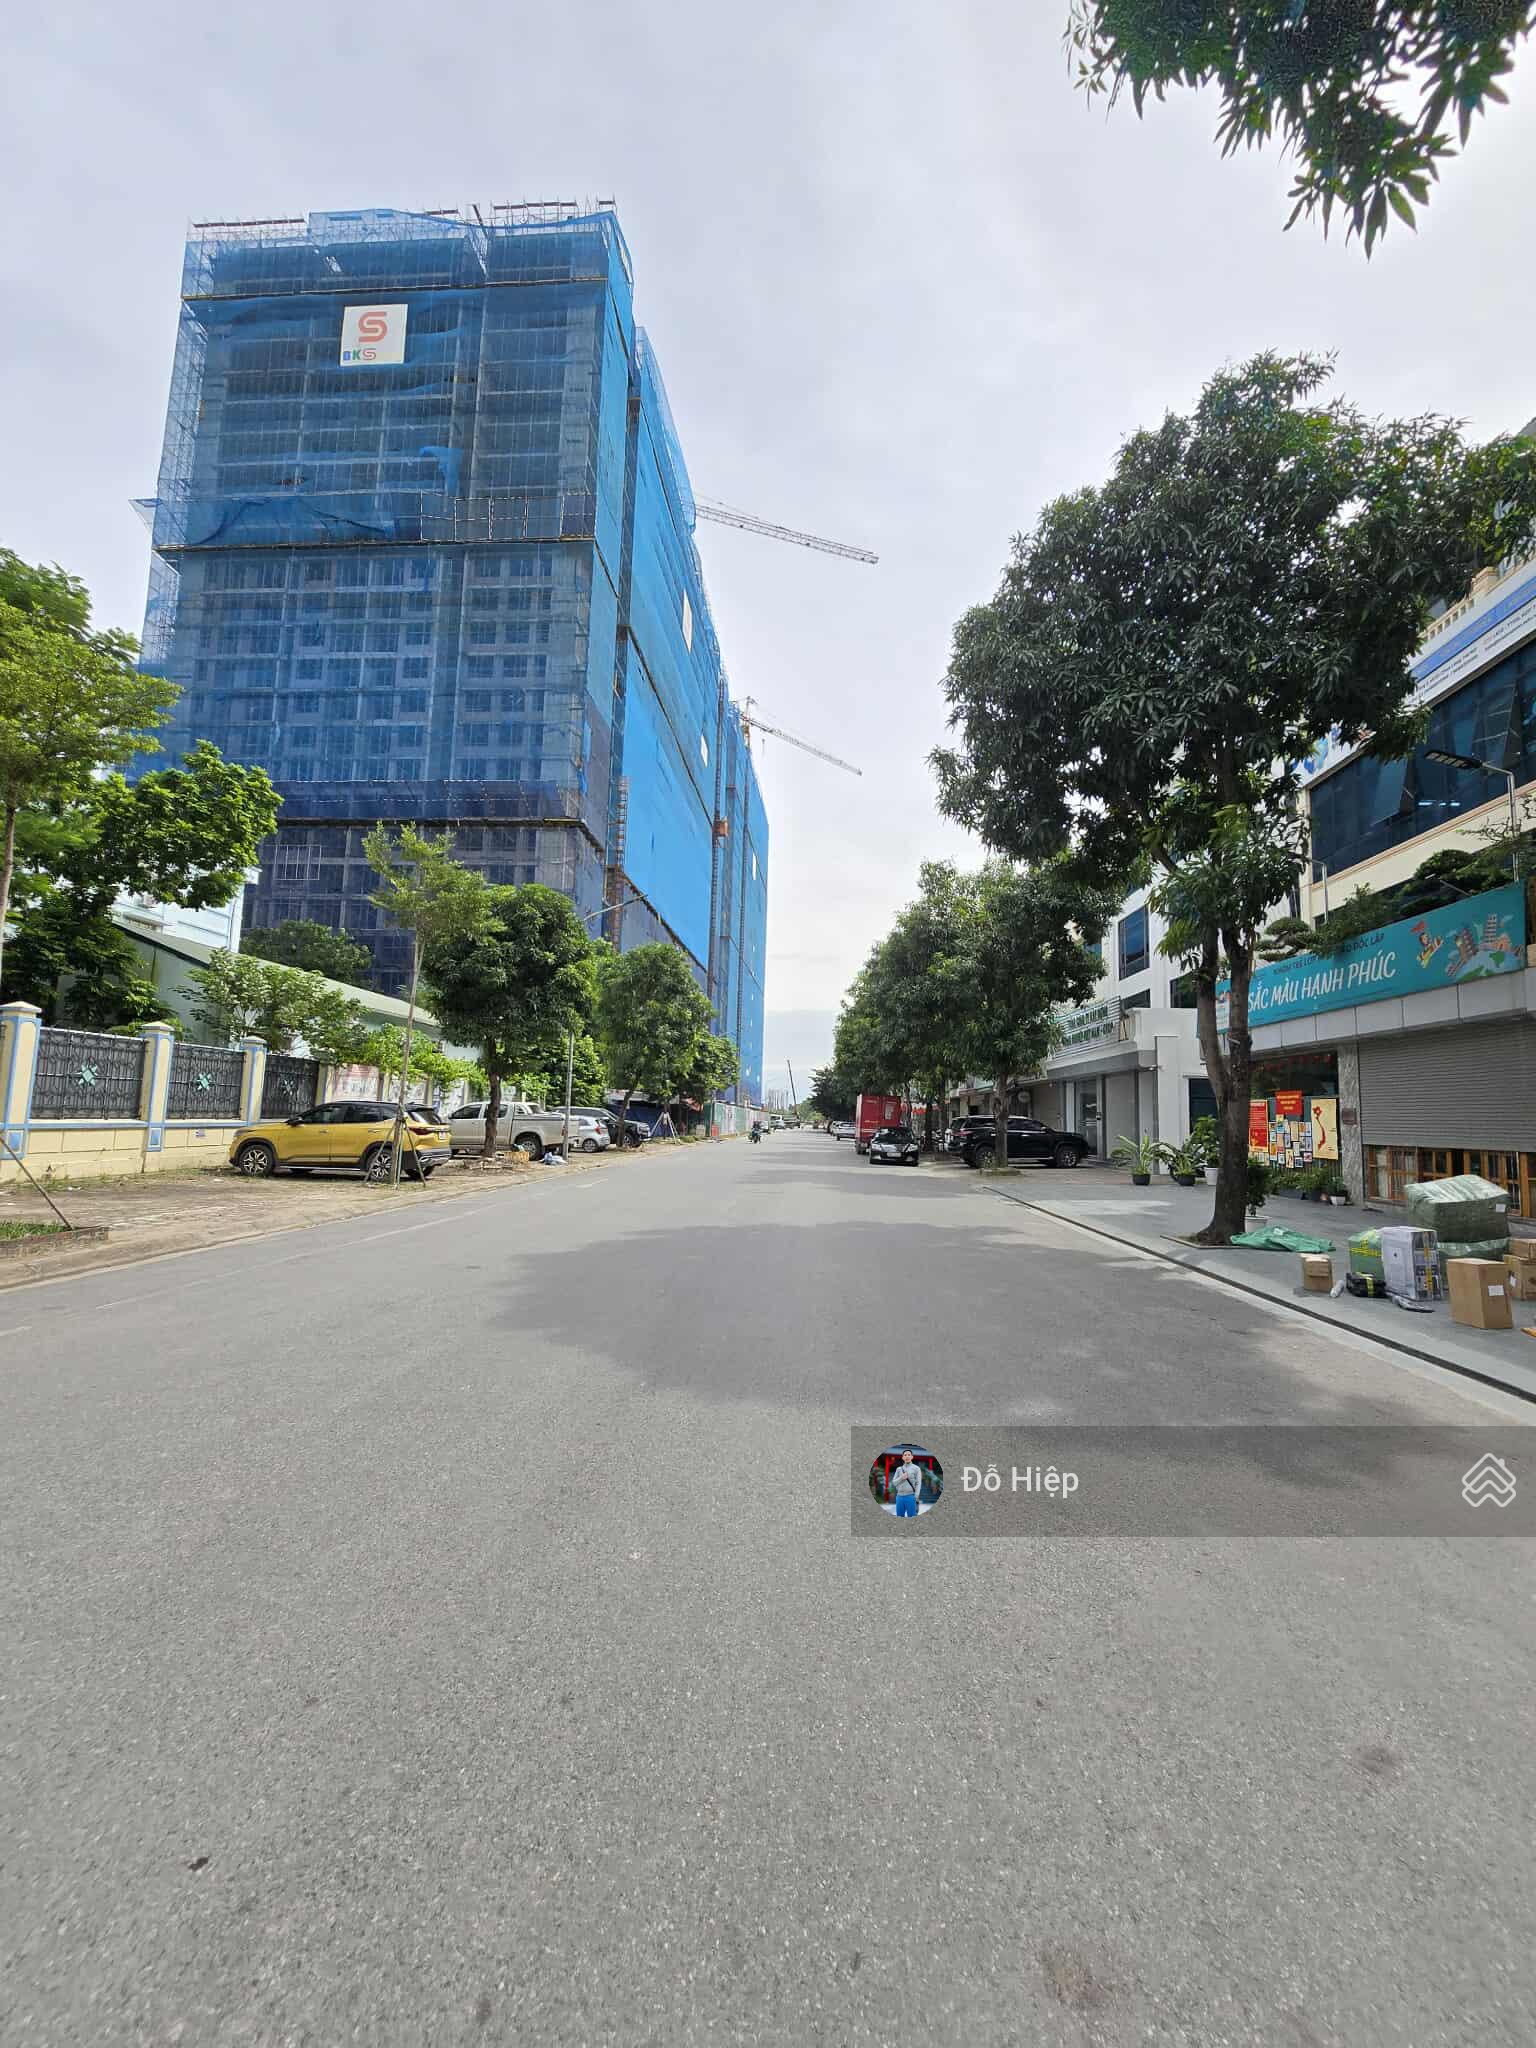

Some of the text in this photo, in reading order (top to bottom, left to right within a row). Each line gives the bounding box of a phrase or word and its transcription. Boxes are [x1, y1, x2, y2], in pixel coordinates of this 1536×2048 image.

[1248, 979, 1269, 1012] SẮC
[1271, 976, 1299, 1006] MÀU
[1301, 967, 1344, 1000] HẠNH
[1347, 950, 1397, 989] PHÚC
